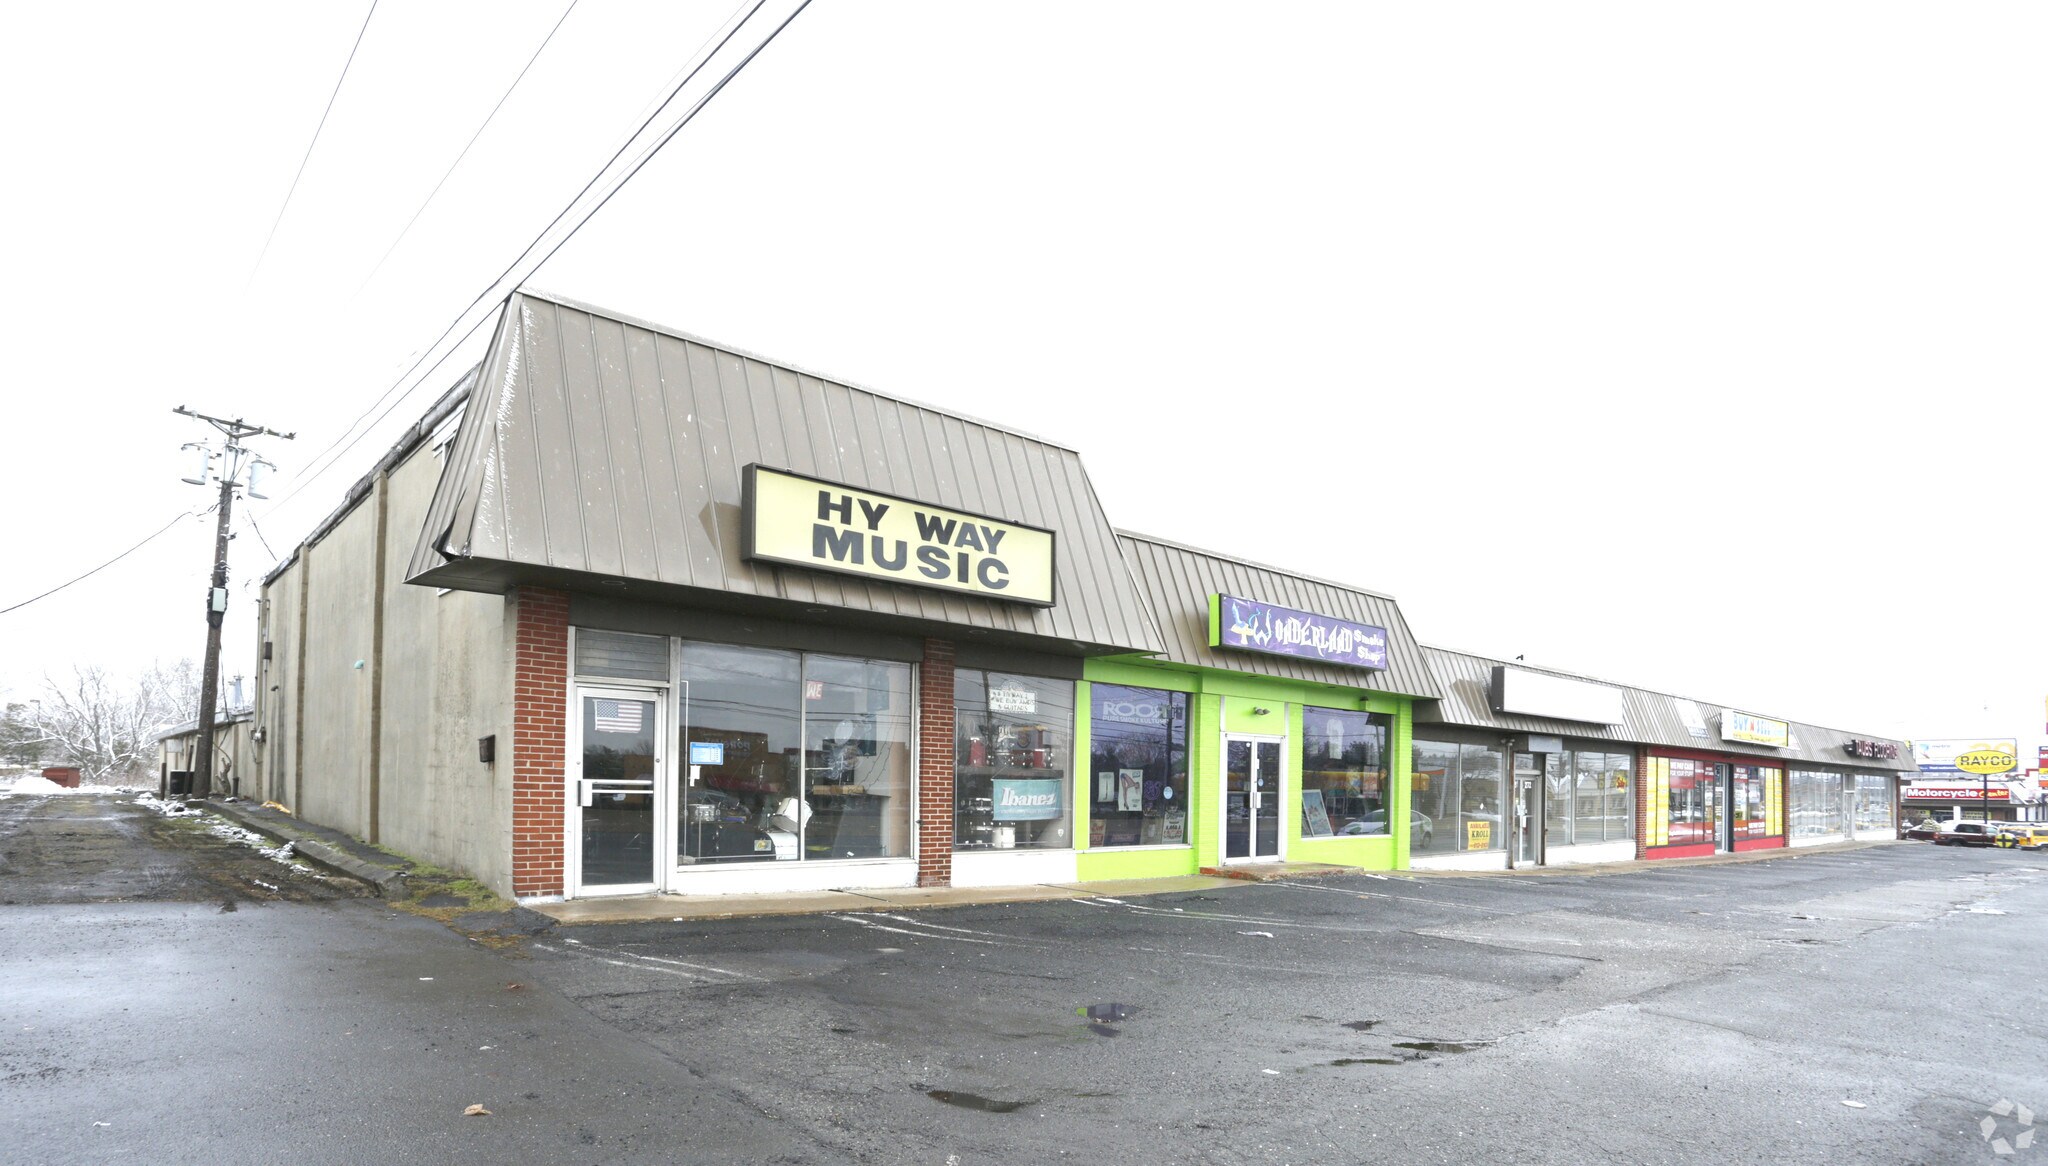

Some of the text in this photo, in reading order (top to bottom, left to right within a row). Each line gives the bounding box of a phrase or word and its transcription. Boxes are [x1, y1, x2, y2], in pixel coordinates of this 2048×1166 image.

[817, 490, 1007, 555] HY WAY
[812, 523, 1010, 590] MUSIC
[1733, 714, 1748, 731] BUY
[1960, 755, 2012, 766] RAYCO
[1000, 787, 1056, 806] Ibanez
[1907, 788, 1978, 798] Motorcycle
[1471, 830, 1489, 838] KROLL
